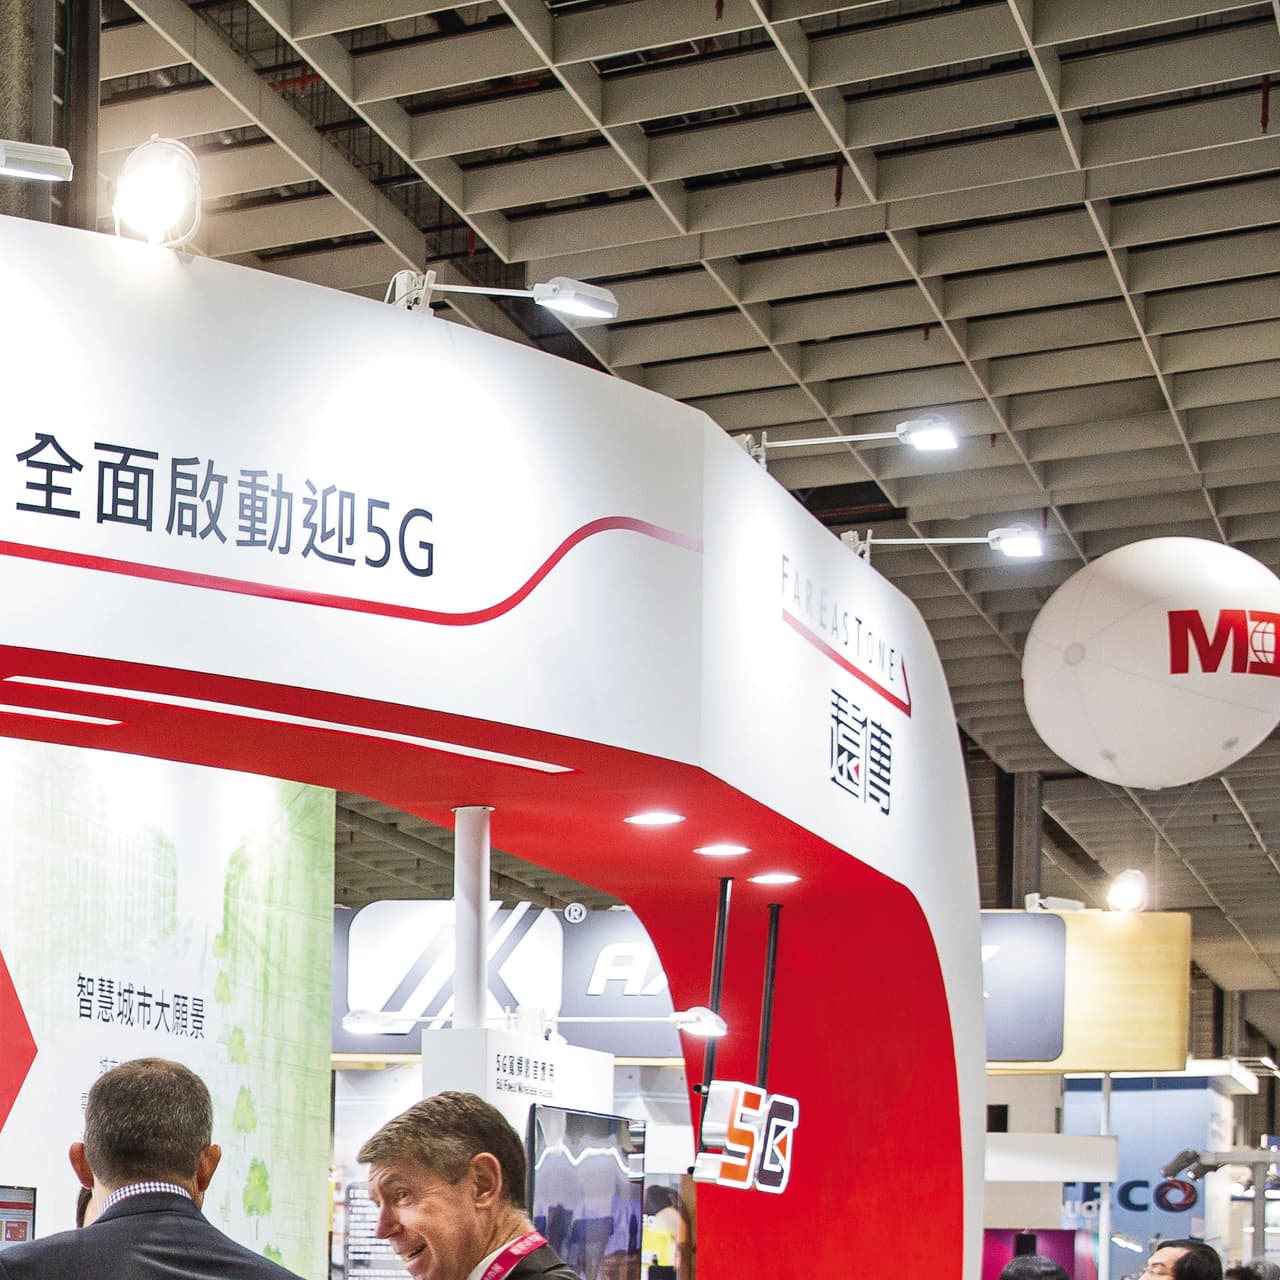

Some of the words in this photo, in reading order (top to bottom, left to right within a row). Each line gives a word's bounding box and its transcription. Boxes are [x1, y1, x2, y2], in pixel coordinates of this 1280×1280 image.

[15, 431, 435, 577] 全面啟動迎5G
[781, 554, 895, 681] FAREASTONE
[830, 688, 893, 816] 遠傳
[77, 972, 205, 1039] 智慧城市大願景
